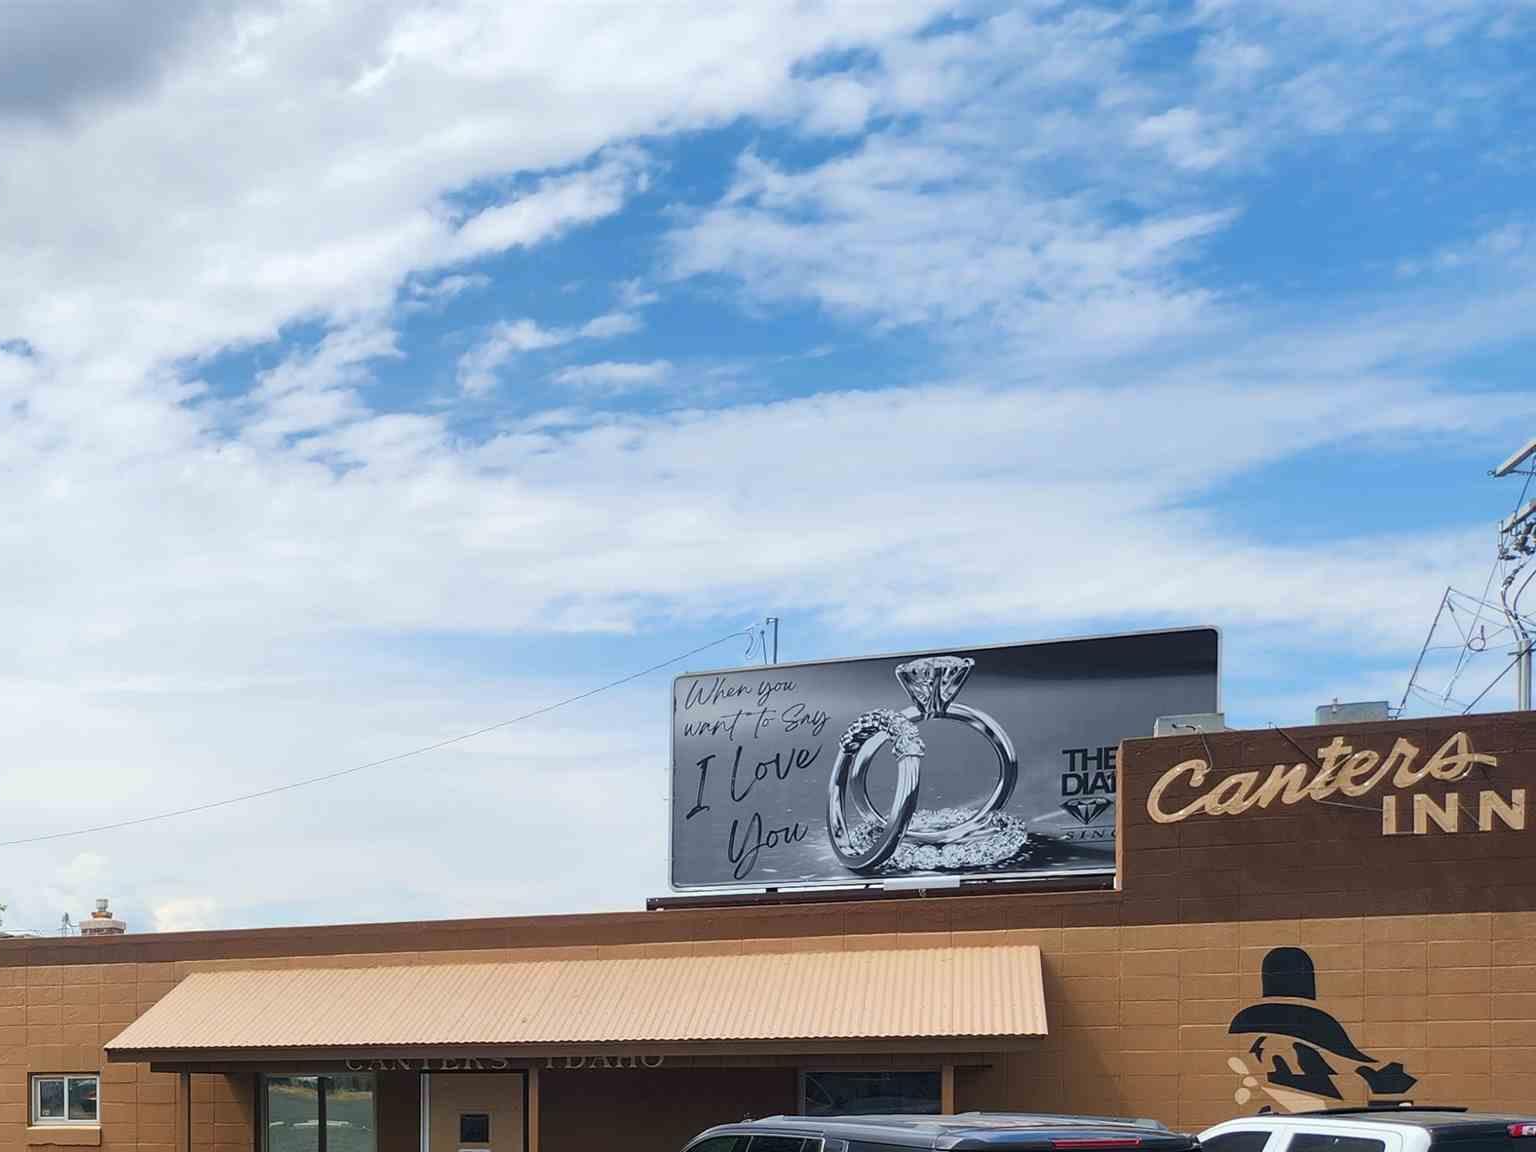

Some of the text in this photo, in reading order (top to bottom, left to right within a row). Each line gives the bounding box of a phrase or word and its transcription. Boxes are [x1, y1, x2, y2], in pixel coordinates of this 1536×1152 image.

[685, 677, 797, 709] When you
[684, 703, 832, 741] want to Say
[686, 744, 823, 820] I Love
[1062, 746, 1118, 772] THE
[1146, 731, 1497, 824] Canters
[1382, 788, 1526, 835] INN
[728, 812, 809, 880] You
